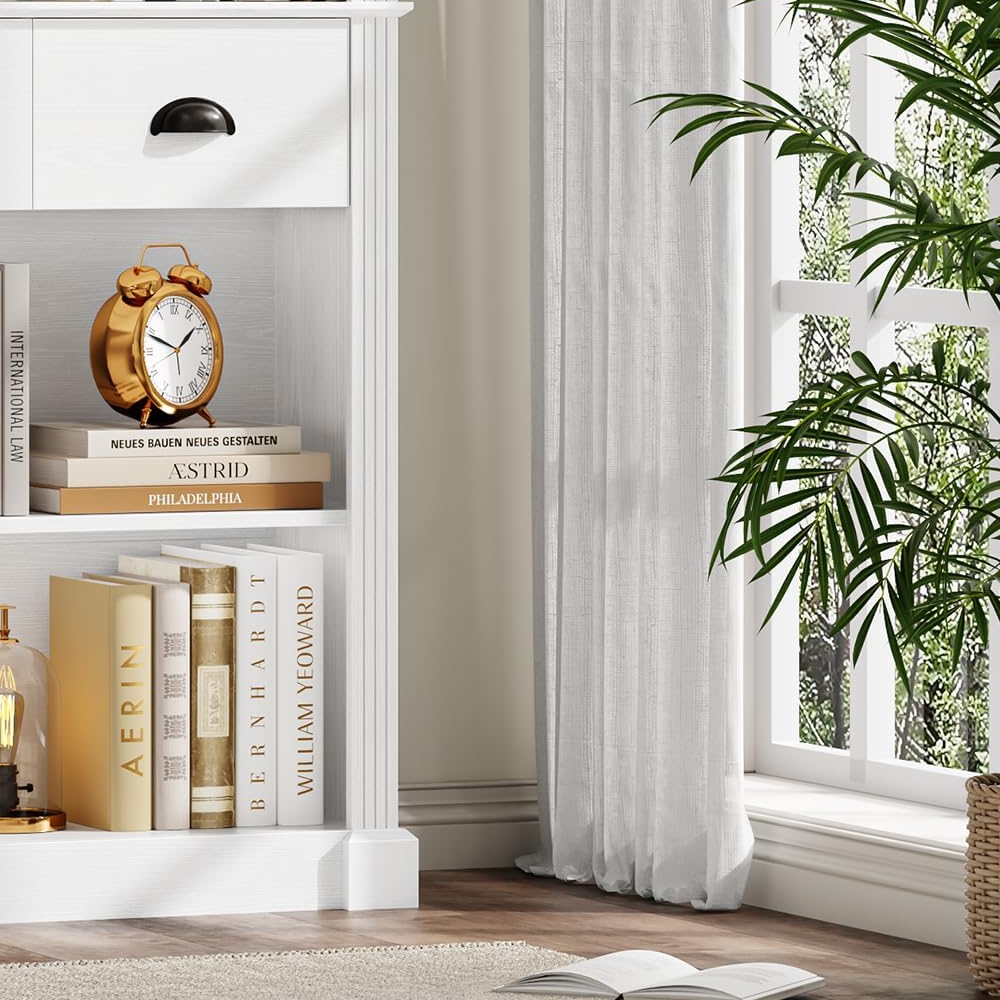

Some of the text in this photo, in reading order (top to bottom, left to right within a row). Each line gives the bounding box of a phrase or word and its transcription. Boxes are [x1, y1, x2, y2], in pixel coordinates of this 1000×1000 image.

[10, 330, 24, 463] INTERNATIONAL LAW
[111, 435, 278, 449] NEUES BAUEN NEUES GESTALTEN
[148, 492, 242, 506] PHILADELPHIA
[168, 462, 249, 480] ÆSTRID
[120, 644, 144, 777] AERIN
[250, 574, 266, 811] BERNHARDT
[296, 585, 314, 796] WILLIAM YEOWARD
